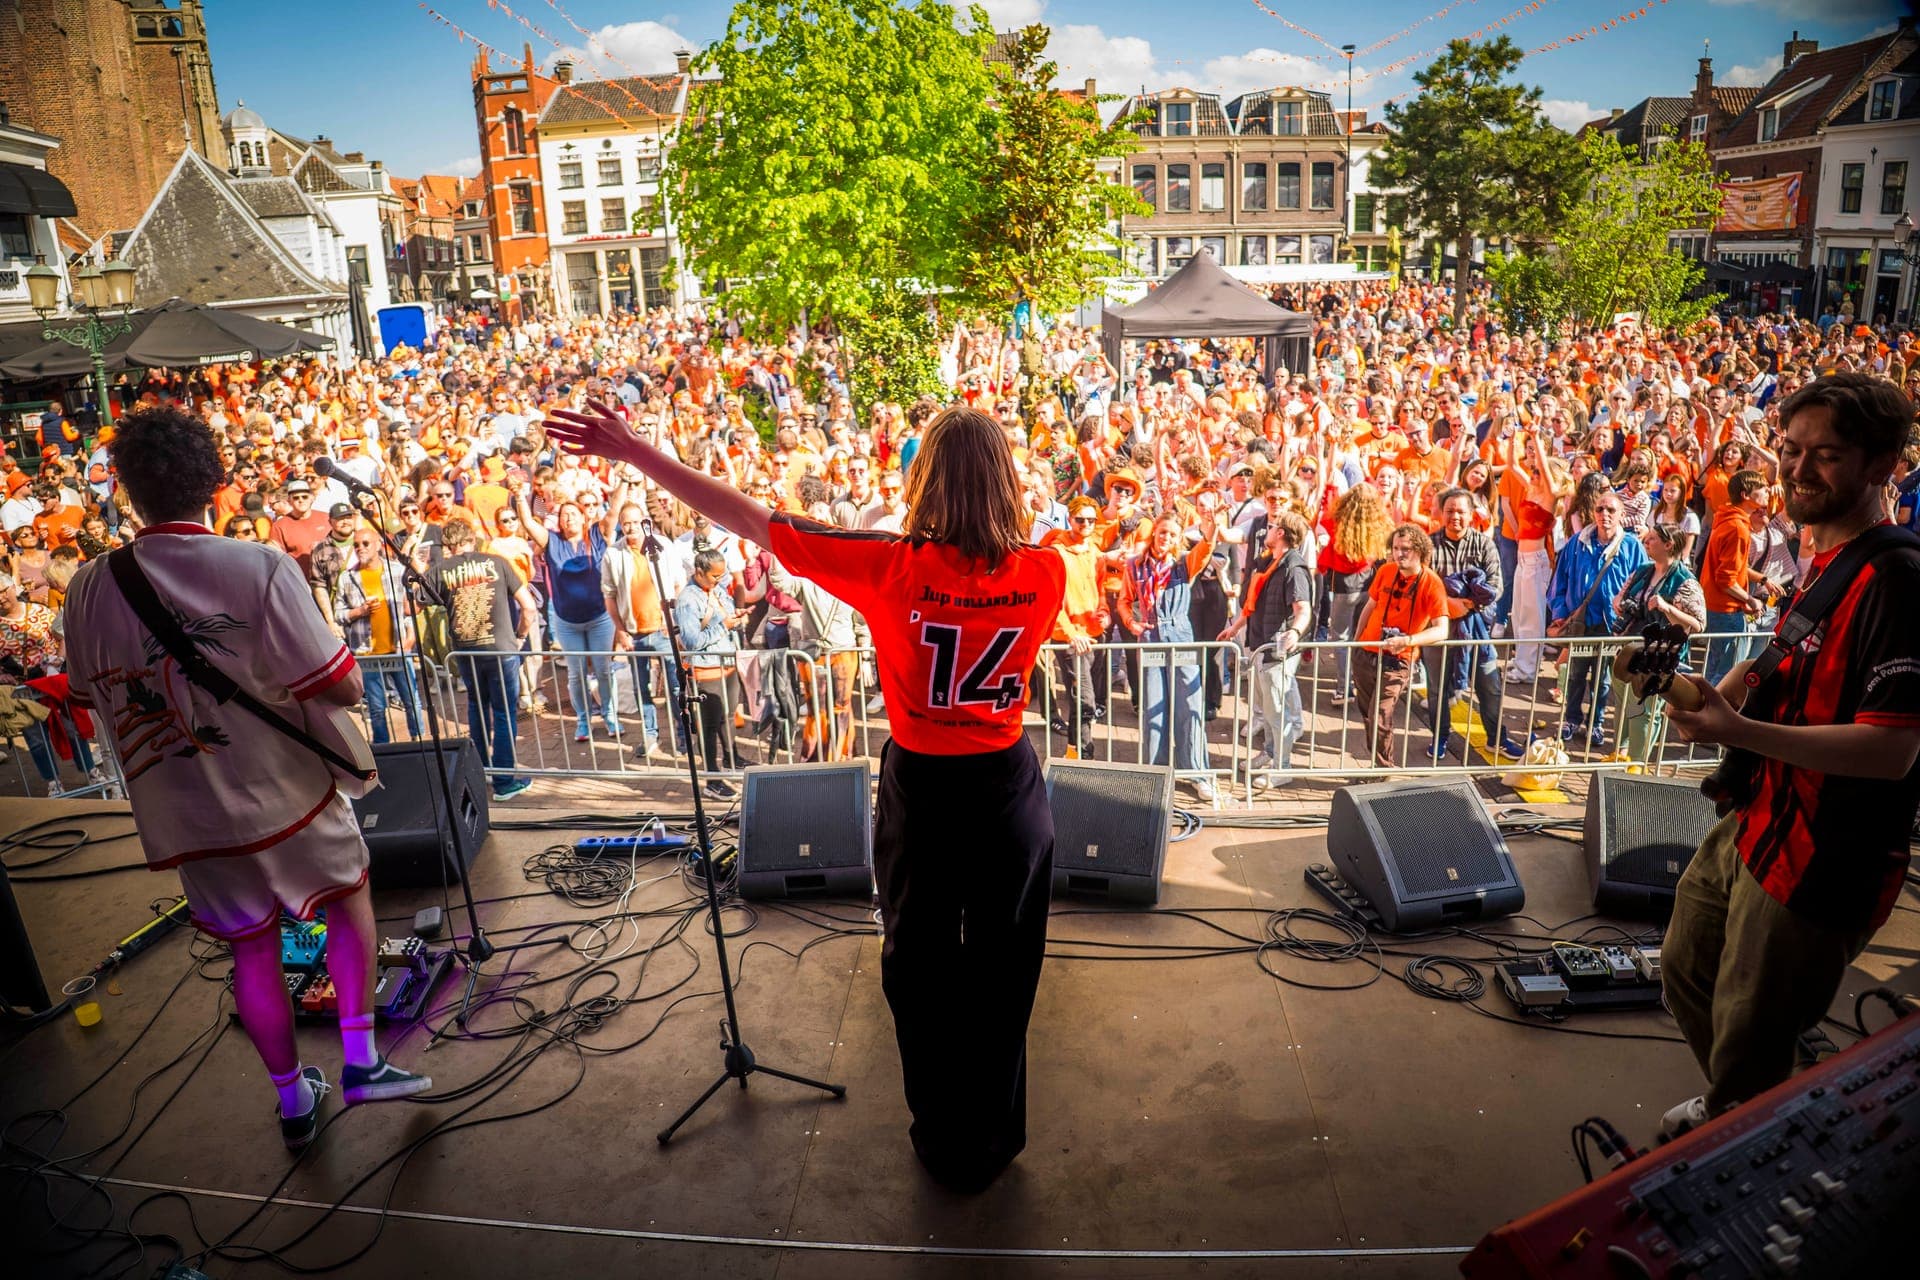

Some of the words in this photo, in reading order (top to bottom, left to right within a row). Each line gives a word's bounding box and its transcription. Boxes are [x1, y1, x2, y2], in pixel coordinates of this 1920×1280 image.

[457, 559, 499, 587] FLAMES
[919, 586, 950, 607] Jup
[1008, 590, 1036, 607] Jup
